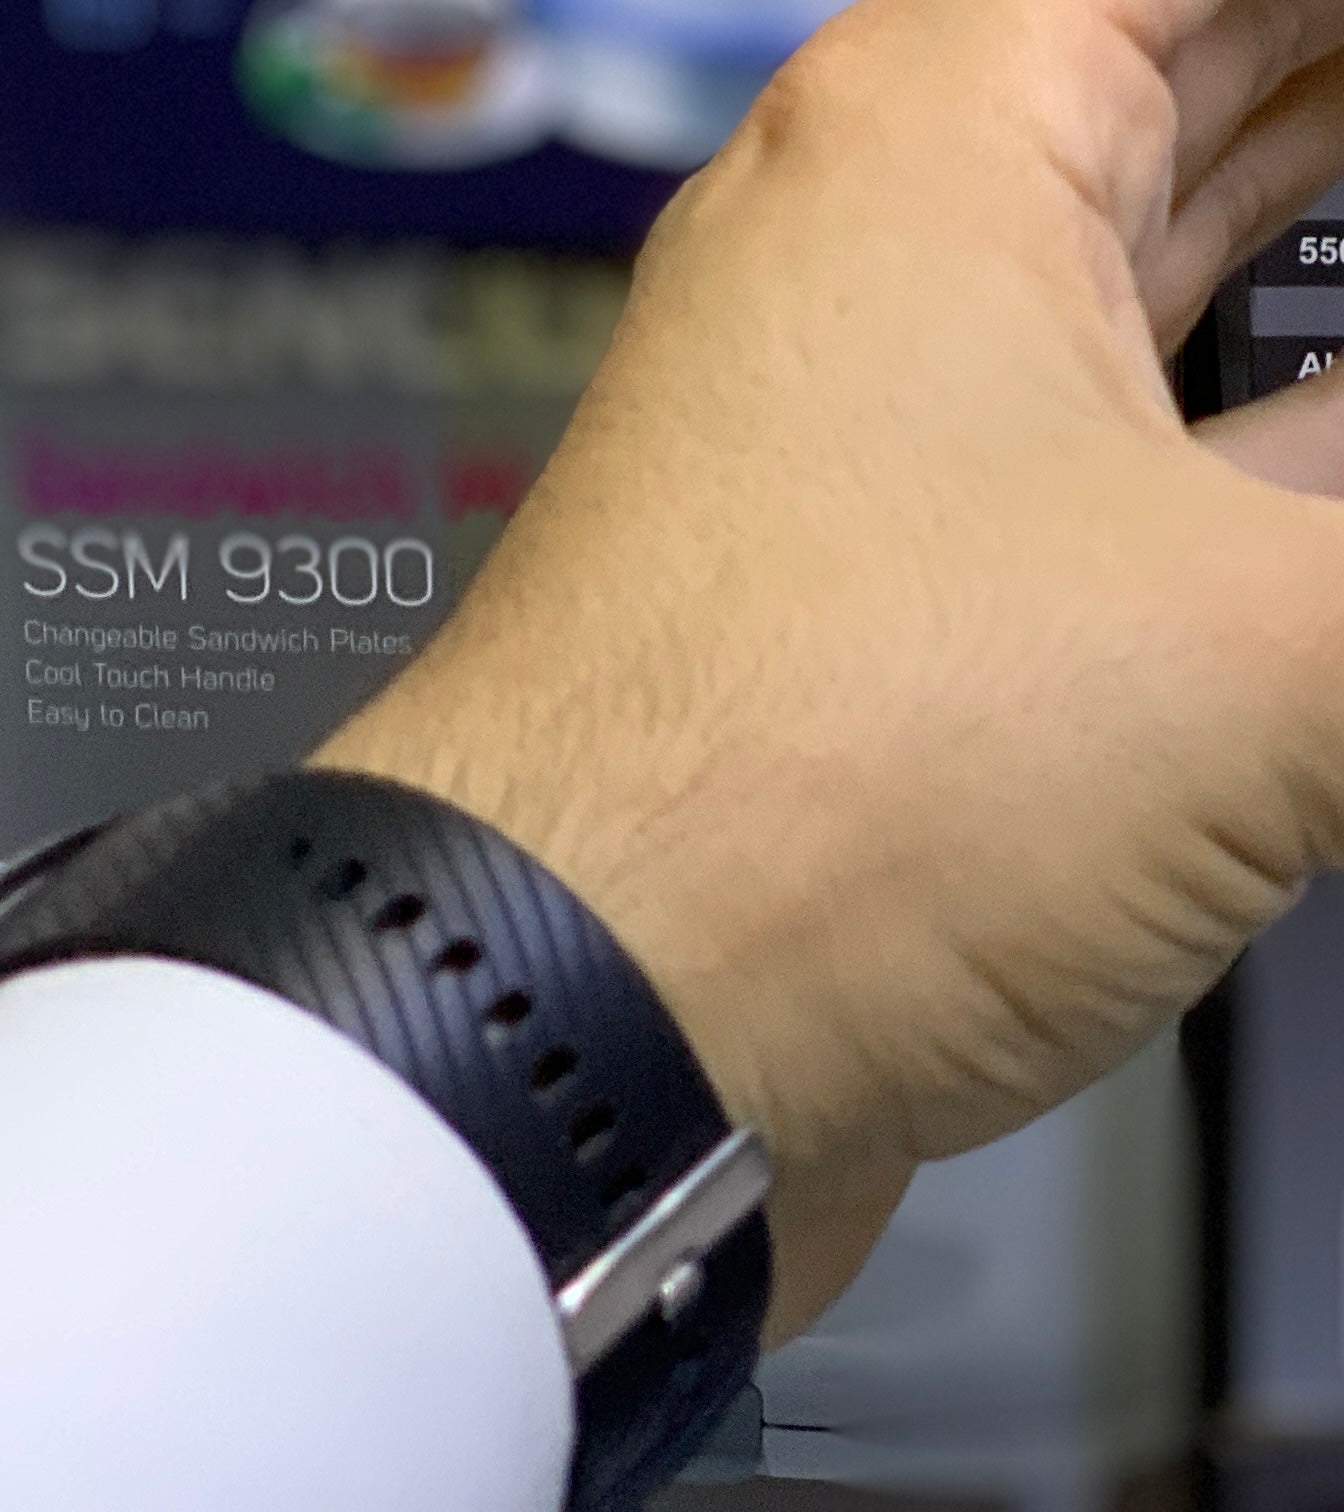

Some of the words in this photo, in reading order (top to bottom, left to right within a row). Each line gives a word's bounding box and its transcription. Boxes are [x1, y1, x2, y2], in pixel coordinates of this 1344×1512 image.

[17, 523, 190, 601] SSM
[218, 531, 434, 607] 9300
[23, 618, 178, 652] Changeable
[188, 626, 320, 653] Sandwich
[330, 628, 413, 655] Plates
[25, 659, 81, 687] Cool
[94, 662, 169, 690] Touch
[181, 666, 275, 692] Handle
[27, 699, 89, 731] Easy
[100, 703, 124, 727] to
[135, 704, 209, 730] Clean
